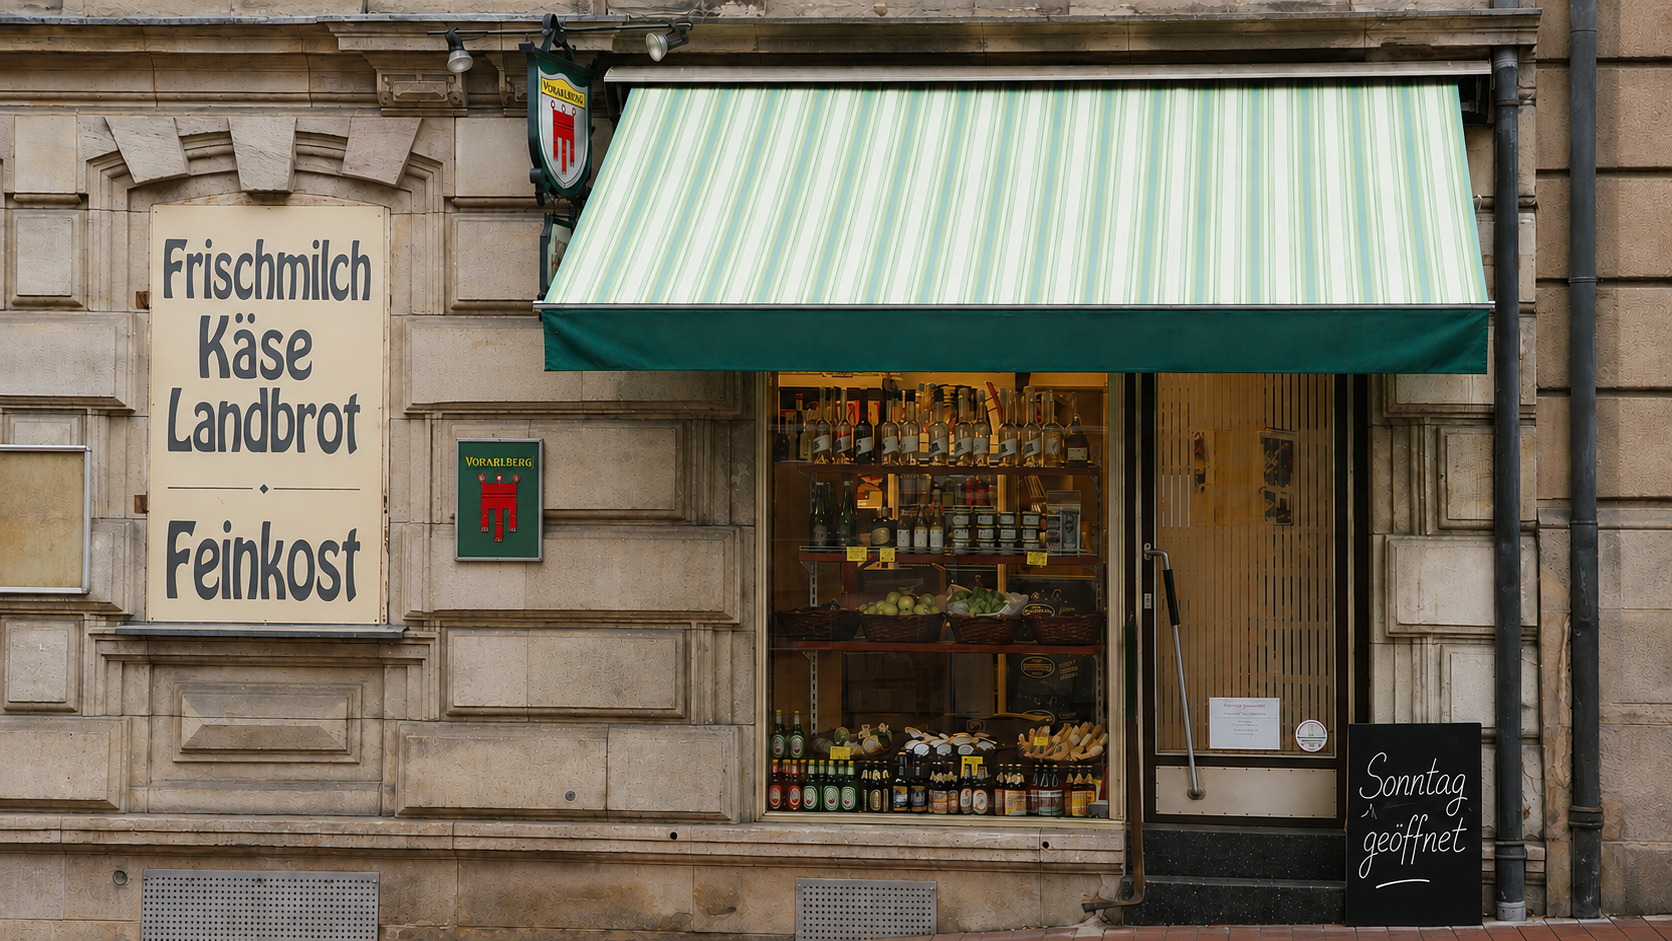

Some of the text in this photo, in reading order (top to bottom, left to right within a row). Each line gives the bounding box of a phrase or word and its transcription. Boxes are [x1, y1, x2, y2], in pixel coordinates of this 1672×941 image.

[164, 239, 371, 301] Frischmilch
[199, 313, 312, 380] Käse
[168, 388, 360, 454] Landbrot
[465, 456, 532, 467] VORARLBERG
[167, 520, 360, 602] Feinkost
[1359, 752, 1467, 817] Sonntag
[1359, 814, 1467, 879] geöffnet
